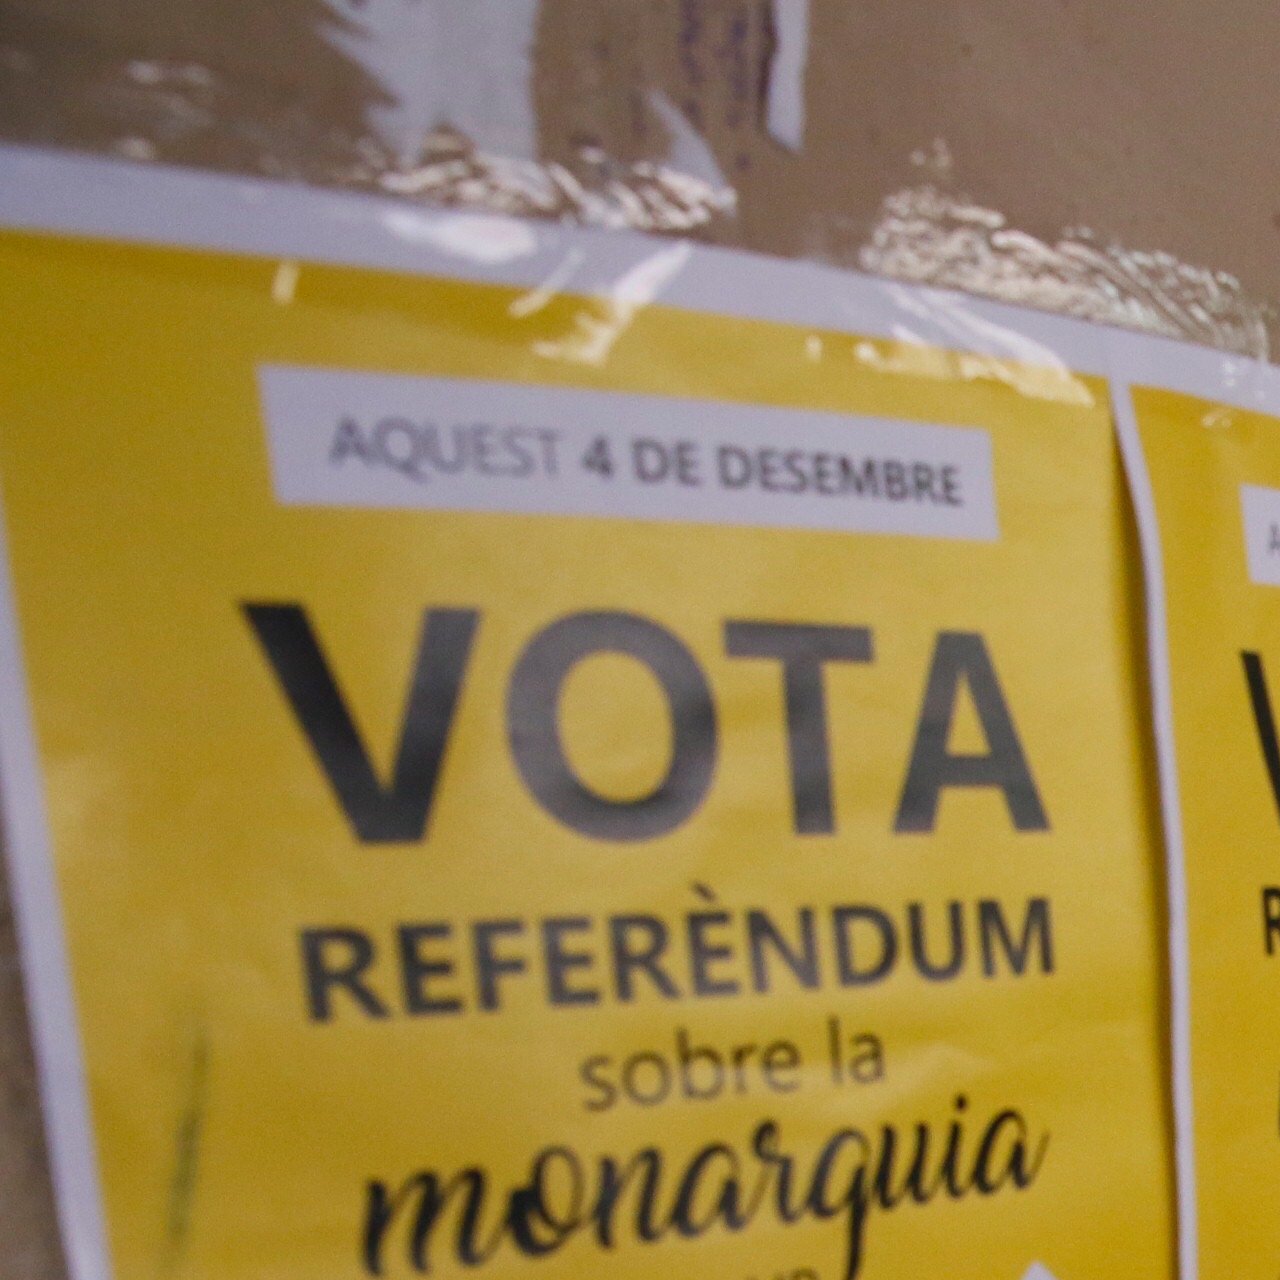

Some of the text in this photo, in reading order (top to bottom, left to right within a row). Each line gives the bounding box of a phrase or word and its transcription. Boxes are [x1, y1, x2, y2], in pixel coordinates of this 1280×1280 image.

[328, 414, 964, 508] AQUEST 4 DE DESEMBRE
[242, 601, 1052, 845] VOTA
[299, 883, 1057, 1023] REFERÈNDUM
[580, 1016, 888, 1113] sobre la
